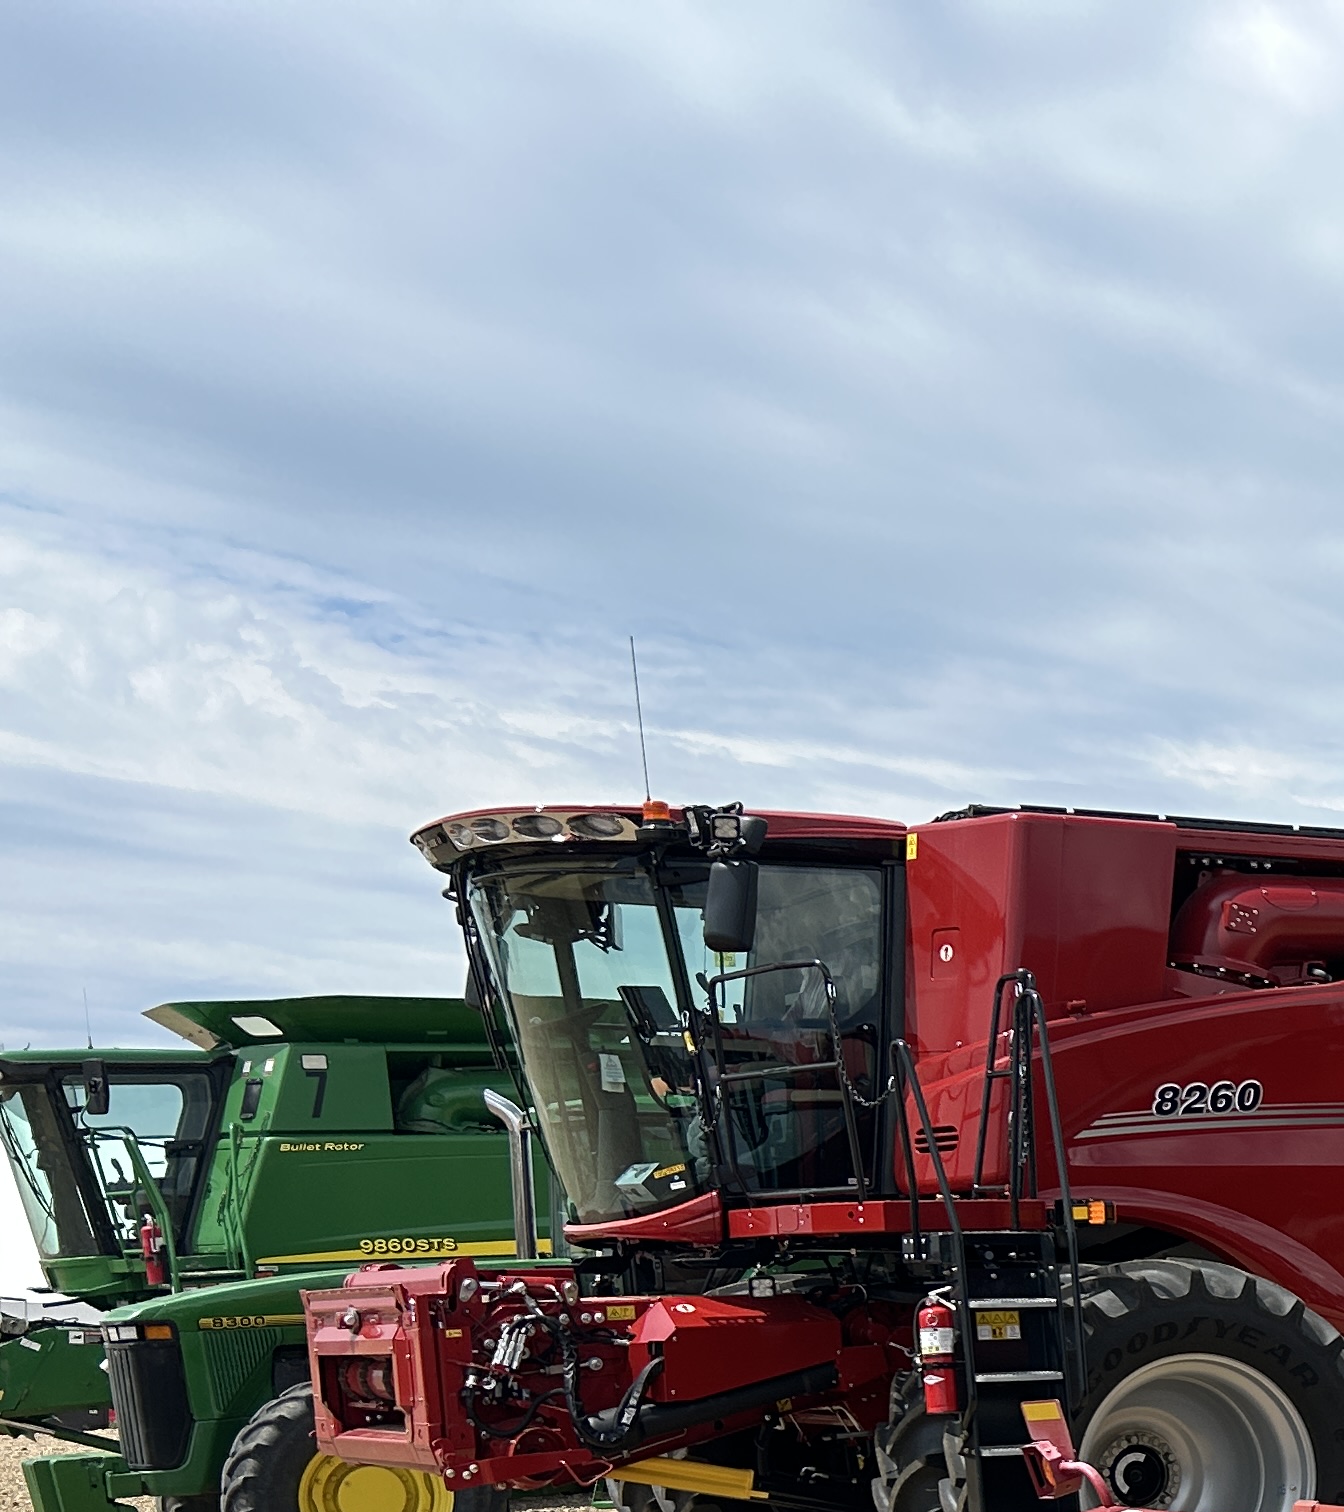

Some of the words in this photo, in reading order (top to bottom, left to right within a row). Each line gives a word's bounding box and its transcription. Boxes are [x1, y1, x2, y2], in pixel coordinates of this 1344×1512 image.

[305, 1071, 327, 1118] 7
[1152, 1079, 1263, 1117] 8260
[280, 1143, 321, 1152] Bullet
[324, 1142, 365, 1151] Rotor
[360, 1238, 458, 1254] 9860STS
[212, 1315, 266, 1329] 8300
